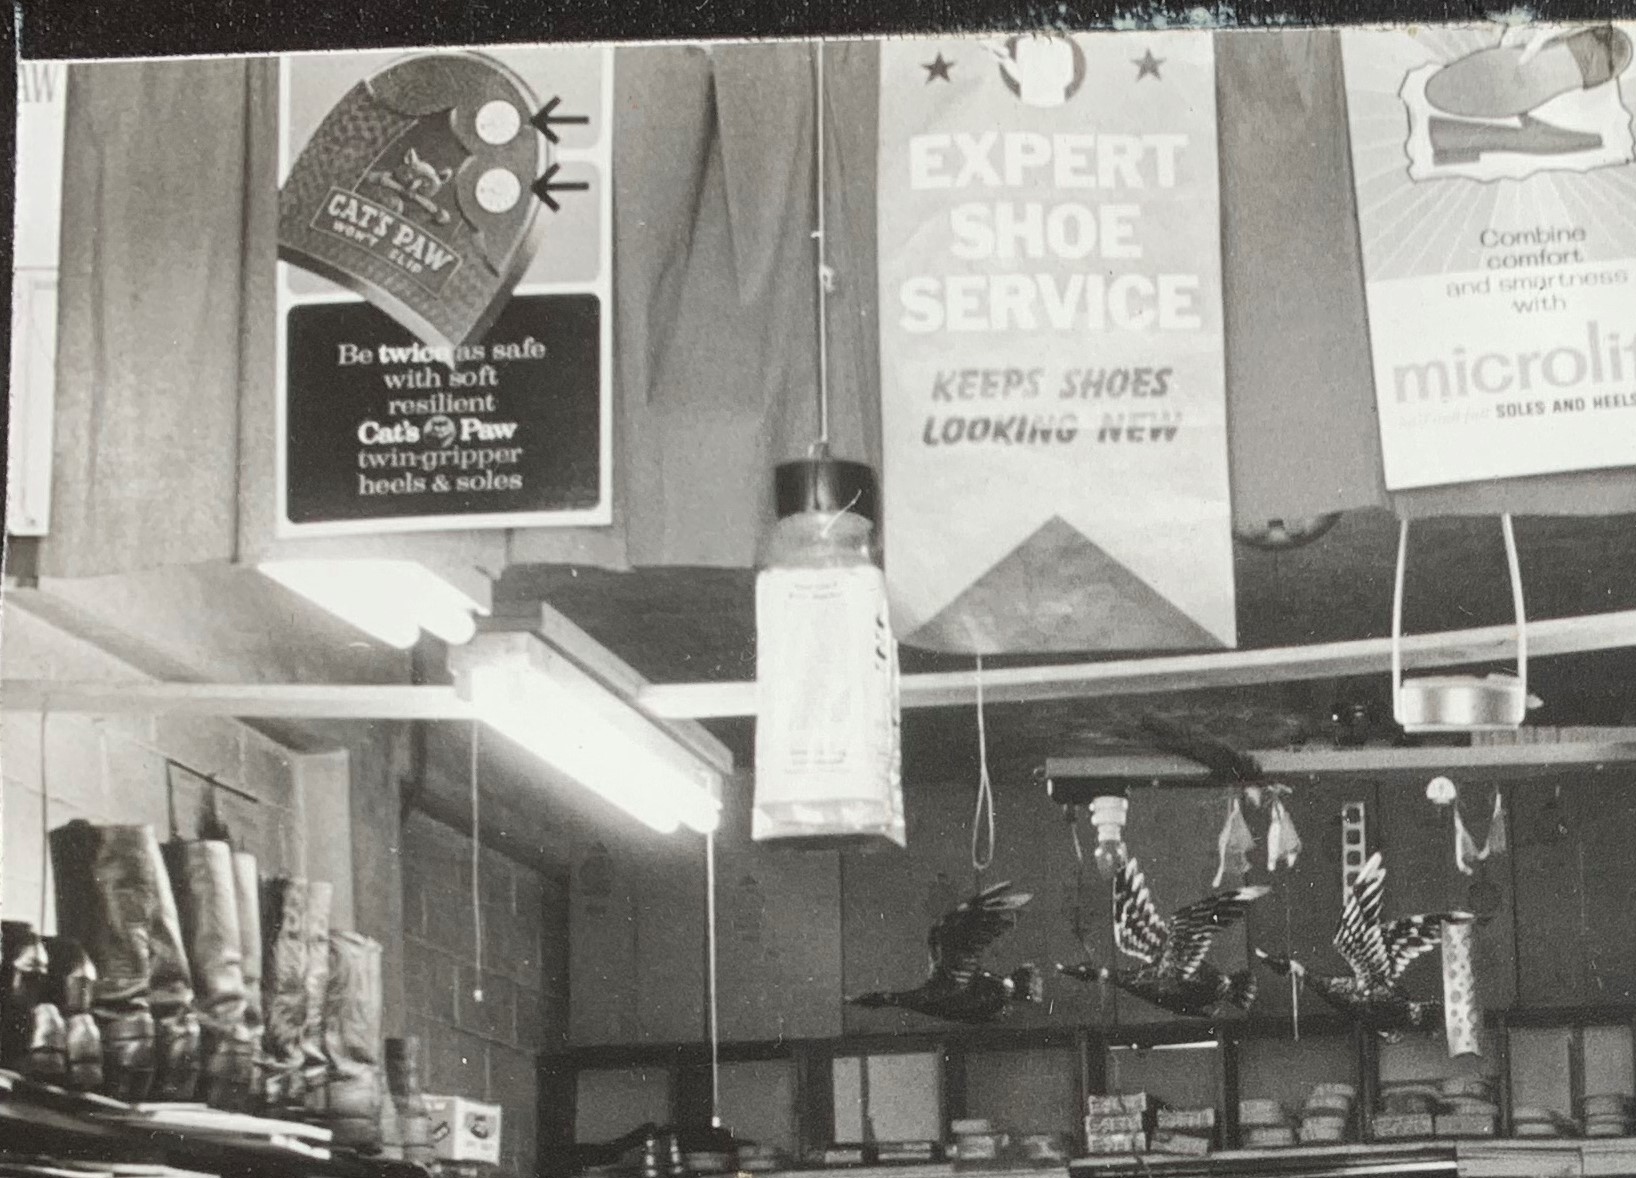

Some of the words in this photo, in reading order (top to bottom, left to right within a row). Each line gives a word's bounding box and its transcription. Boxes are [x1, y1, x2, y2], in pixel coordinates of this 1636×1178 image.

[909, 133, 1188, 190] EXPERT
[328, 194, 394, 237] CAT'S
[392, 224, 453, 271] PAW
[949, 202, 1142, 260] SHOE
[1480, 226, 1587, 248] Combine
[1487, 247, 1584, 270] comfort
[1446, 276, 1491, 298] and
[1499, 268, 1629, 292] smartness
[900, 274, 1201, 333] SERVICE
[1512, 295, 1567, 313] with
[338, 344, 373, 365] Be
[456, 346, 485, 361] as
[492, 336, 546, 360] safe
[384, 367, 441, 389] with
[449, 365, 498, 387] soft
[931, 368, 1043, 403] KEEPS
[1059, 367, 1173, 400] SHOES
[389, 392, 496, 415] resilient
[1496, 401, 1545, 418] SOLES
[1553, 397, 1585, 413] AND
[357, 419, 420, 445] Cat's
[460, 418, 518, 441] Paw
[922, 413, 1078, 447] LOOKING
[1098, 411, 1183, 444] NEW
[358, 446, 523, 470] twin-gripper
[358, 471, 427, 496] heels
[432, 474, 450, 493] &
[456, 469, 523, 491] soles
